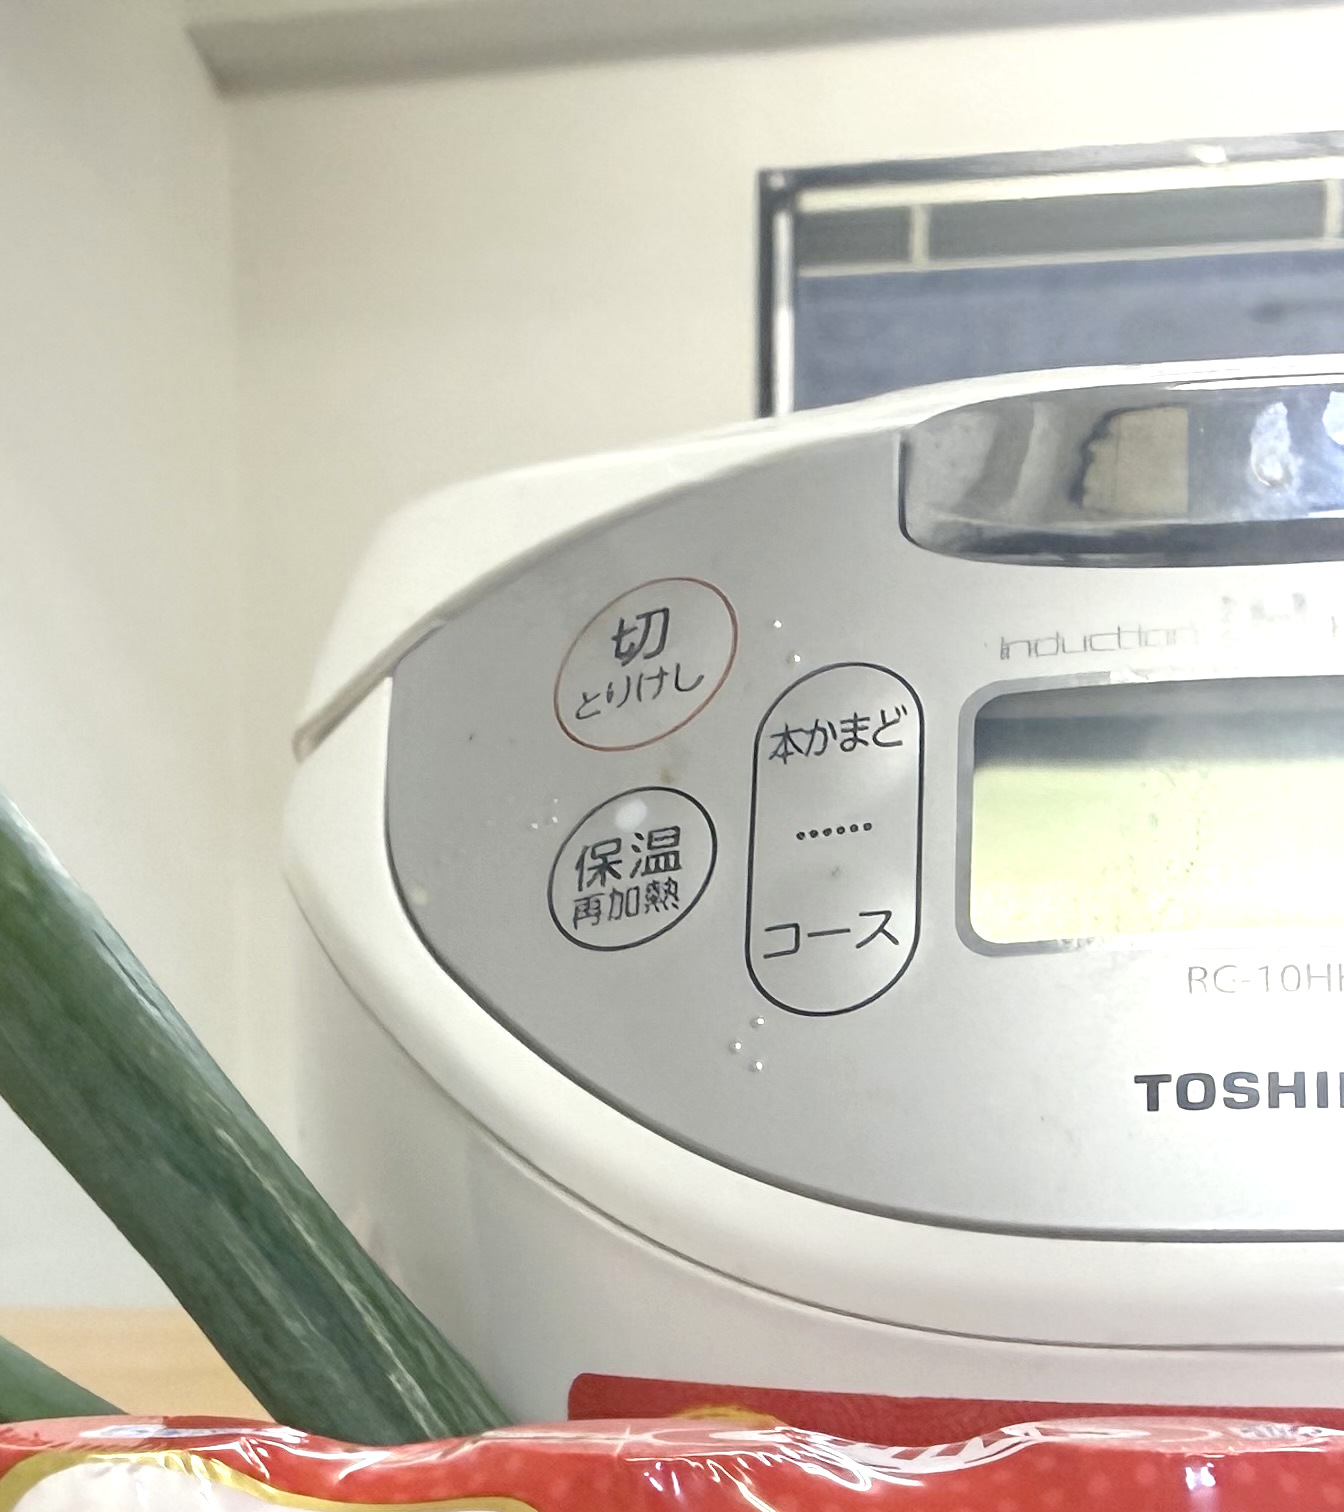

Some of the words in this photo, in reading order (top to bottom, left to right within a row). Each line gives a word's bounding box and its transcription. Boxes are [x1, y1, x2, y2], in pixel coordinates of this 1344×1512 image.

[612, 607, 669, 666] 切
[576, 664, 704, 720] とりけし
[768, 705, 908, 764] 本かまど
[575, 826, 682, 891] 保温
[573, 878, 680, 926] 再加熱
[764, 910, 899, 959] コース
